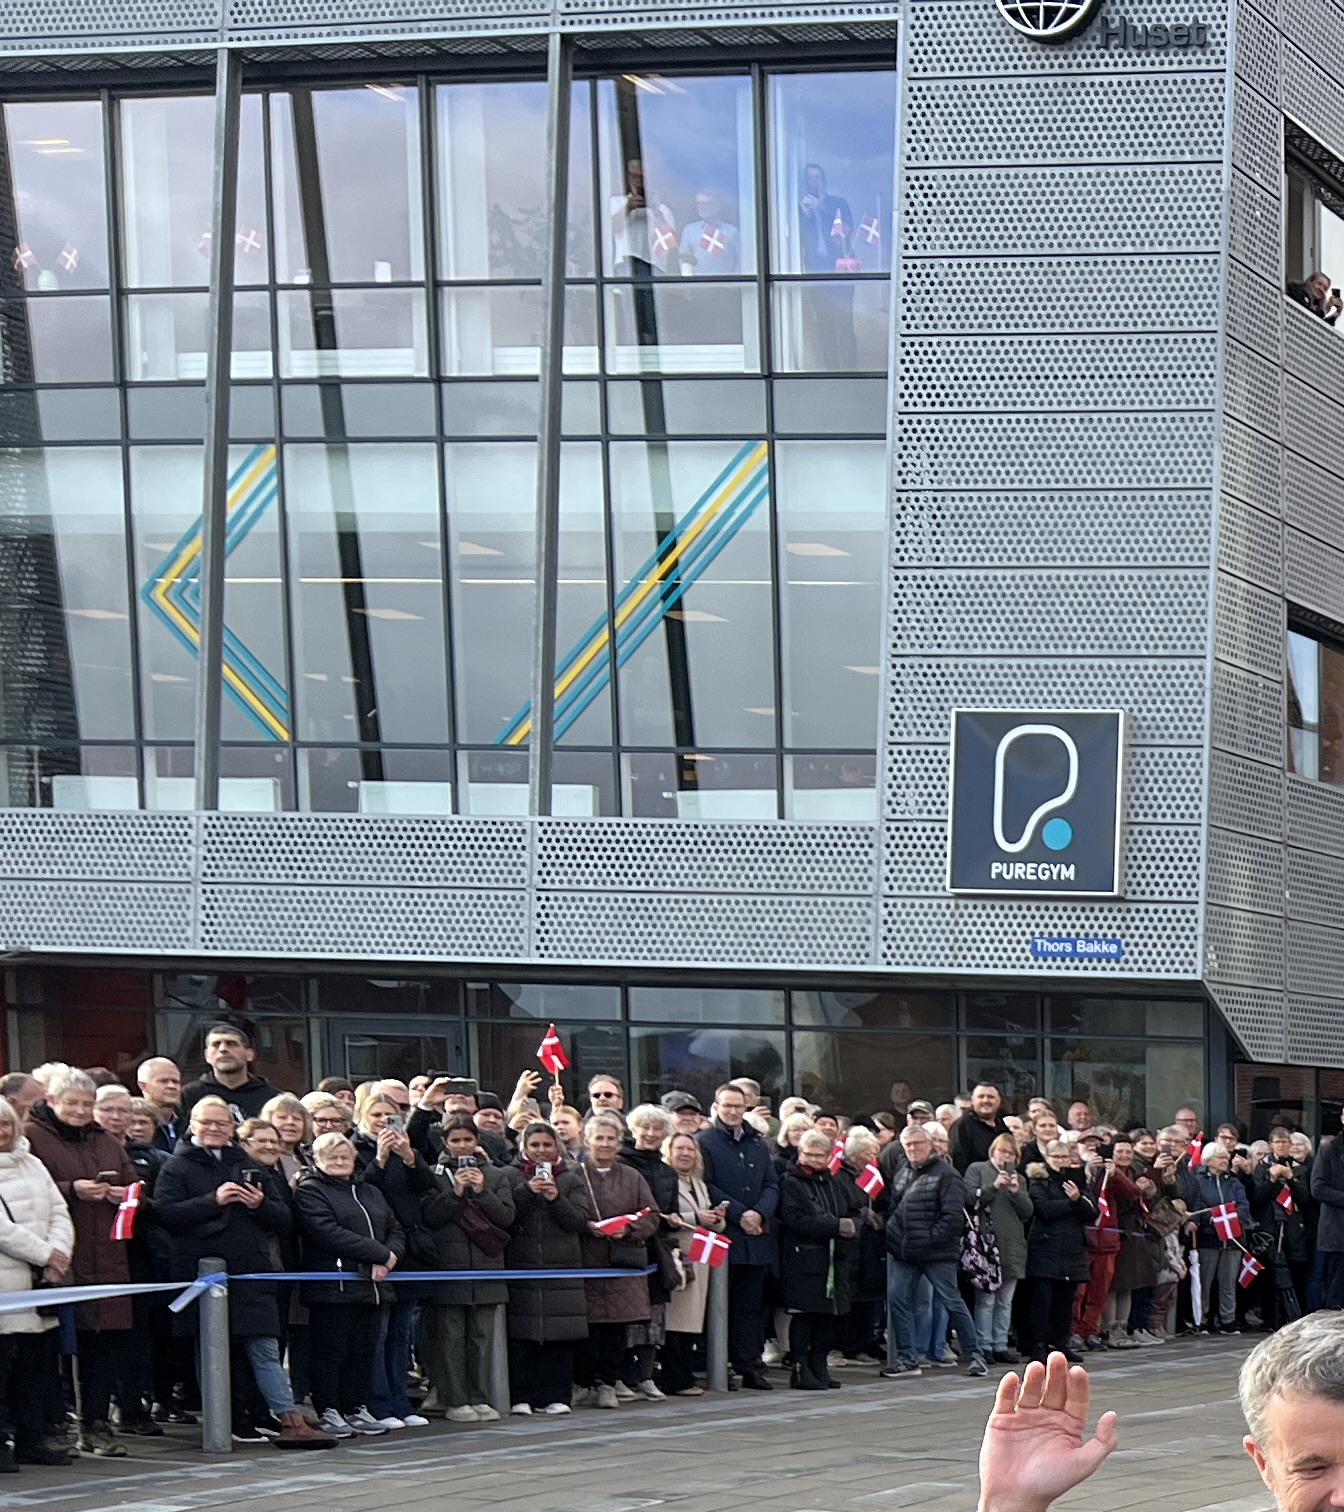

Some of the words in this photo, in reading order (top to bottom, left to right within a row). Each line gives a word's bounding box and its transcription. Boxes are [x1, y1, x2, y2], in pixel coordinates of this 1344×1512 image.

[1099, 15, 1208, 49] Huset
[991, 862, 1076, 880] PUREGYM
[1034, 939, 1073, 953] Thors
[1076, 940, 1118, 953] Bakke
